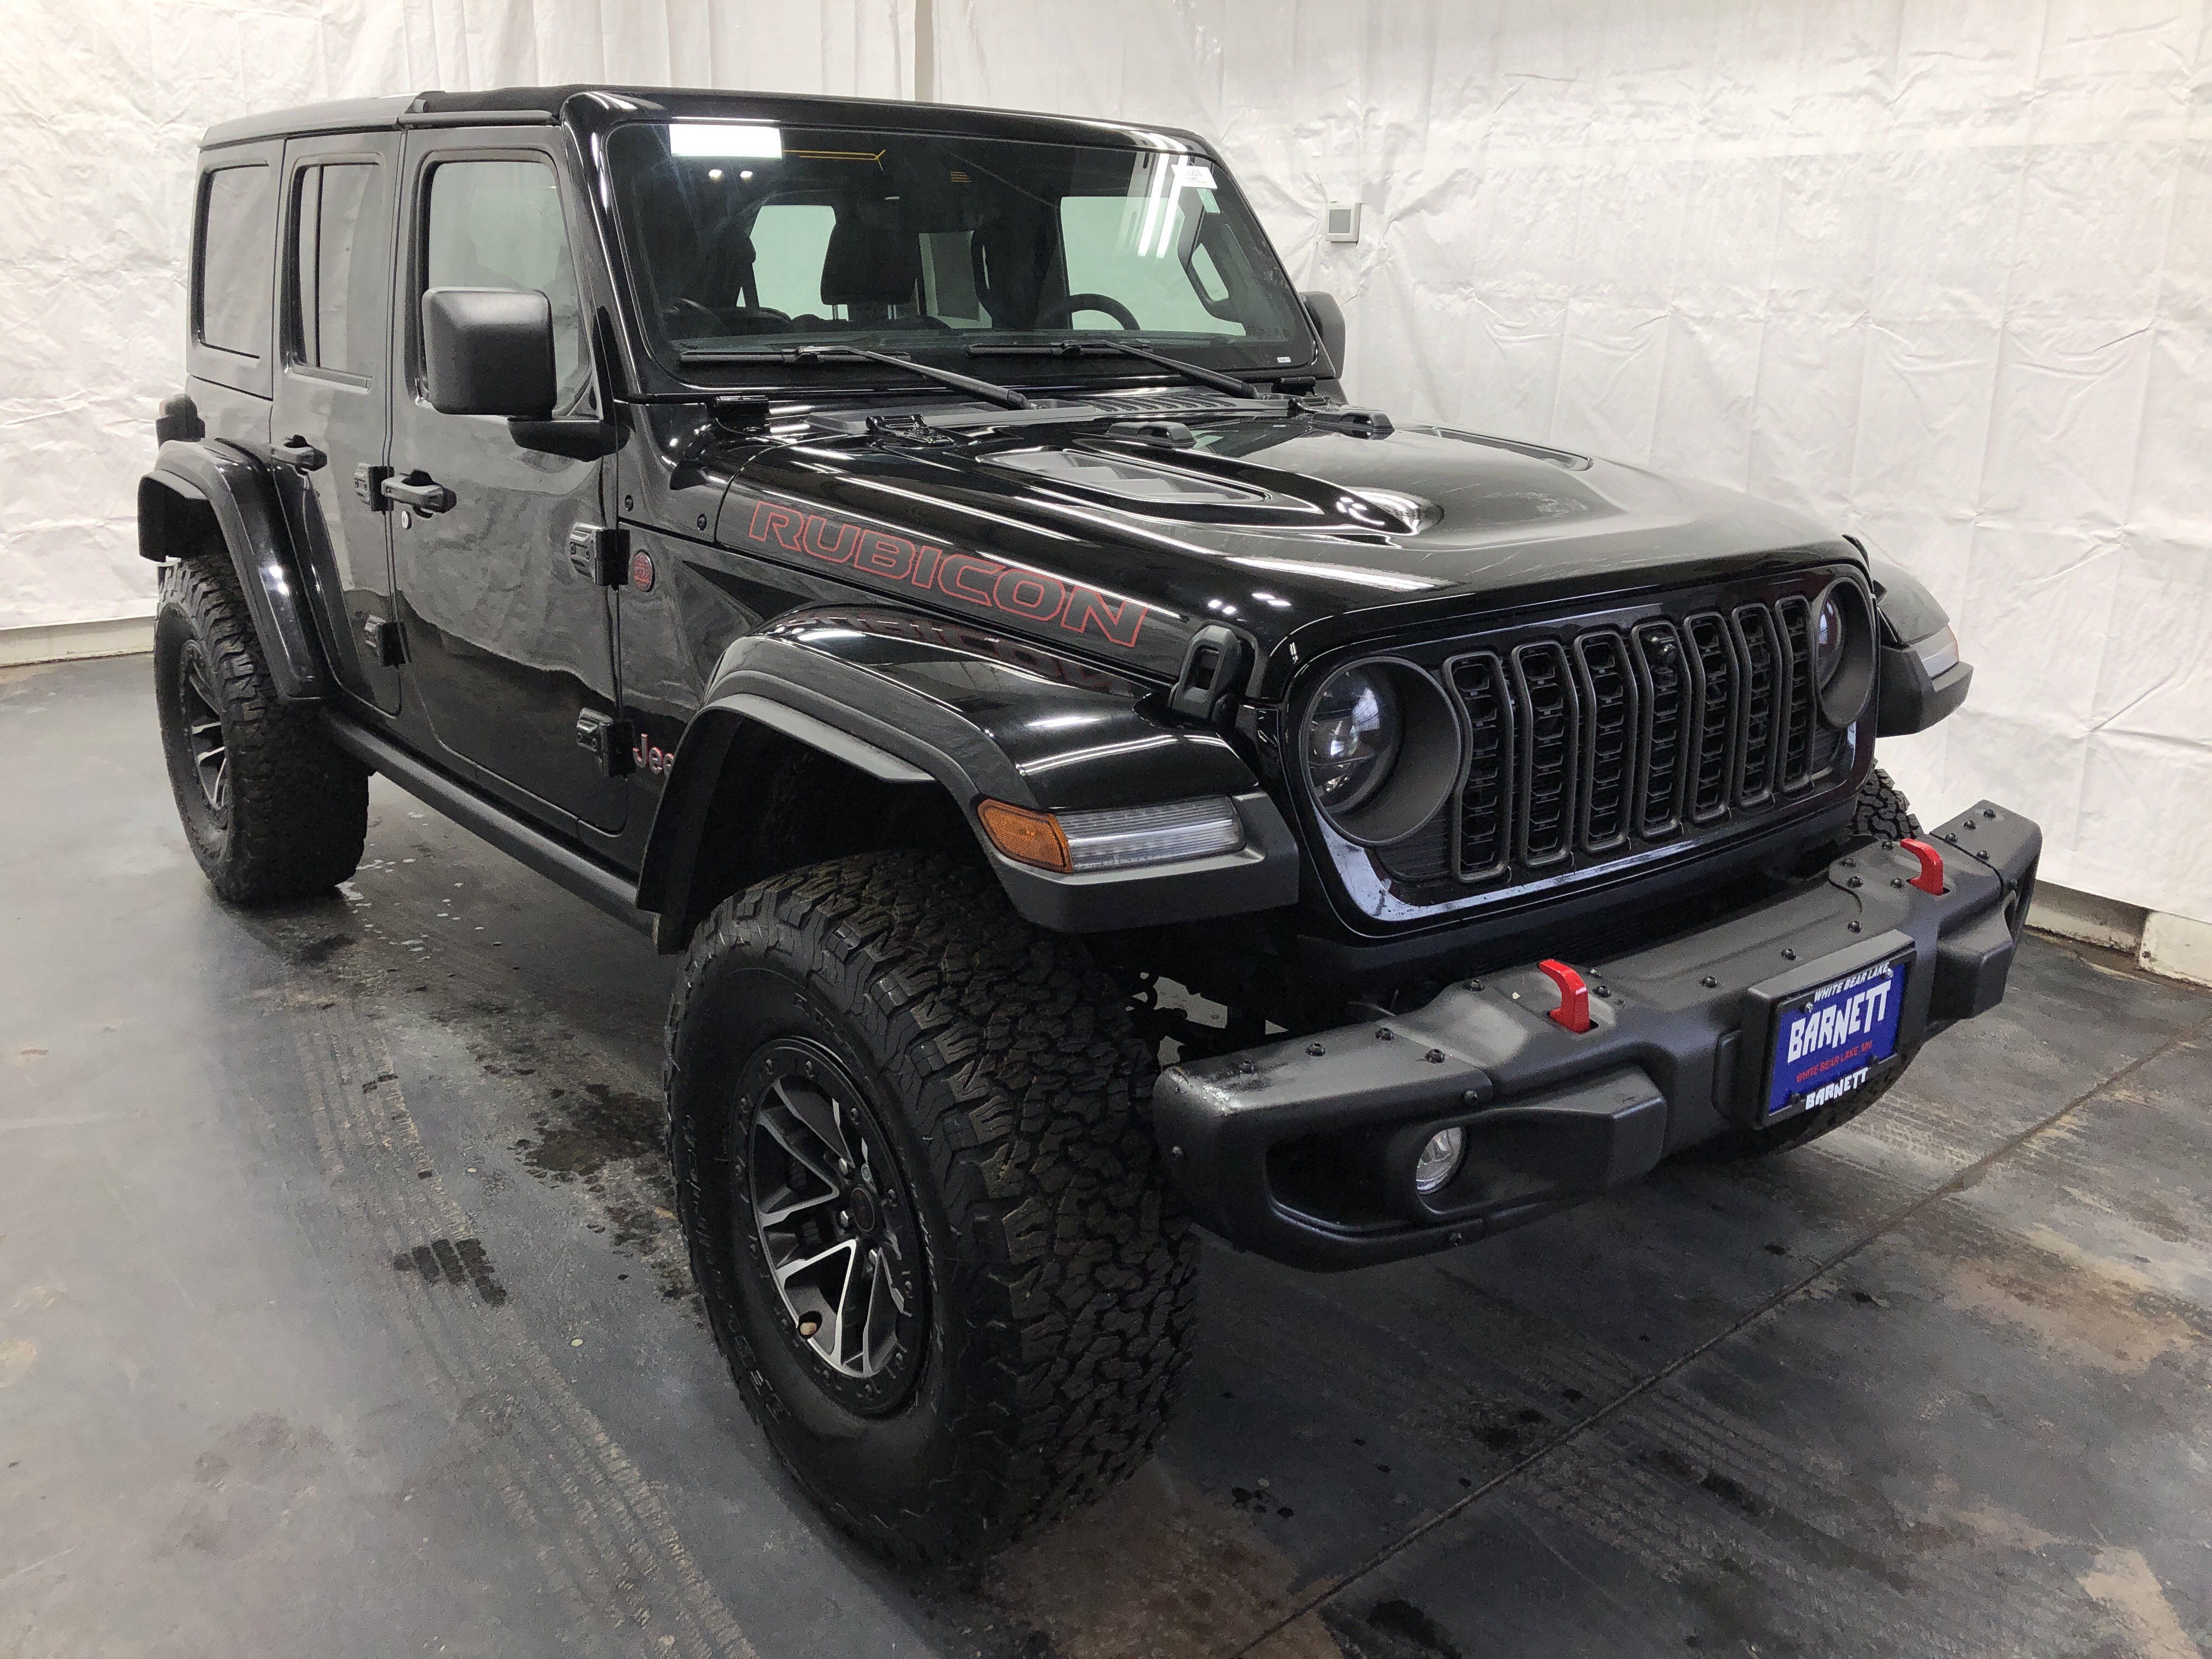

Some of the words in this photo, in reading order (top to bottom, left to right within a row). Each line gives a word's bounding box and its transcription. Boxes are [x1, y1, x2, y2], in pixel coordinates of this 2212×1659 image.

[748, 500, 1148, 647] RUBICON
[632, 732, 674, 777] Jee
[1814, 982, 1845, 1002] WHITE
[1844, 972, 1867, 990] BEAR
[1867, 961, 1890, 980] LAKE
[1787, 980, 1892, 1064] BARNETT
[1805, 1066, 1869, 1110] BARNETT
